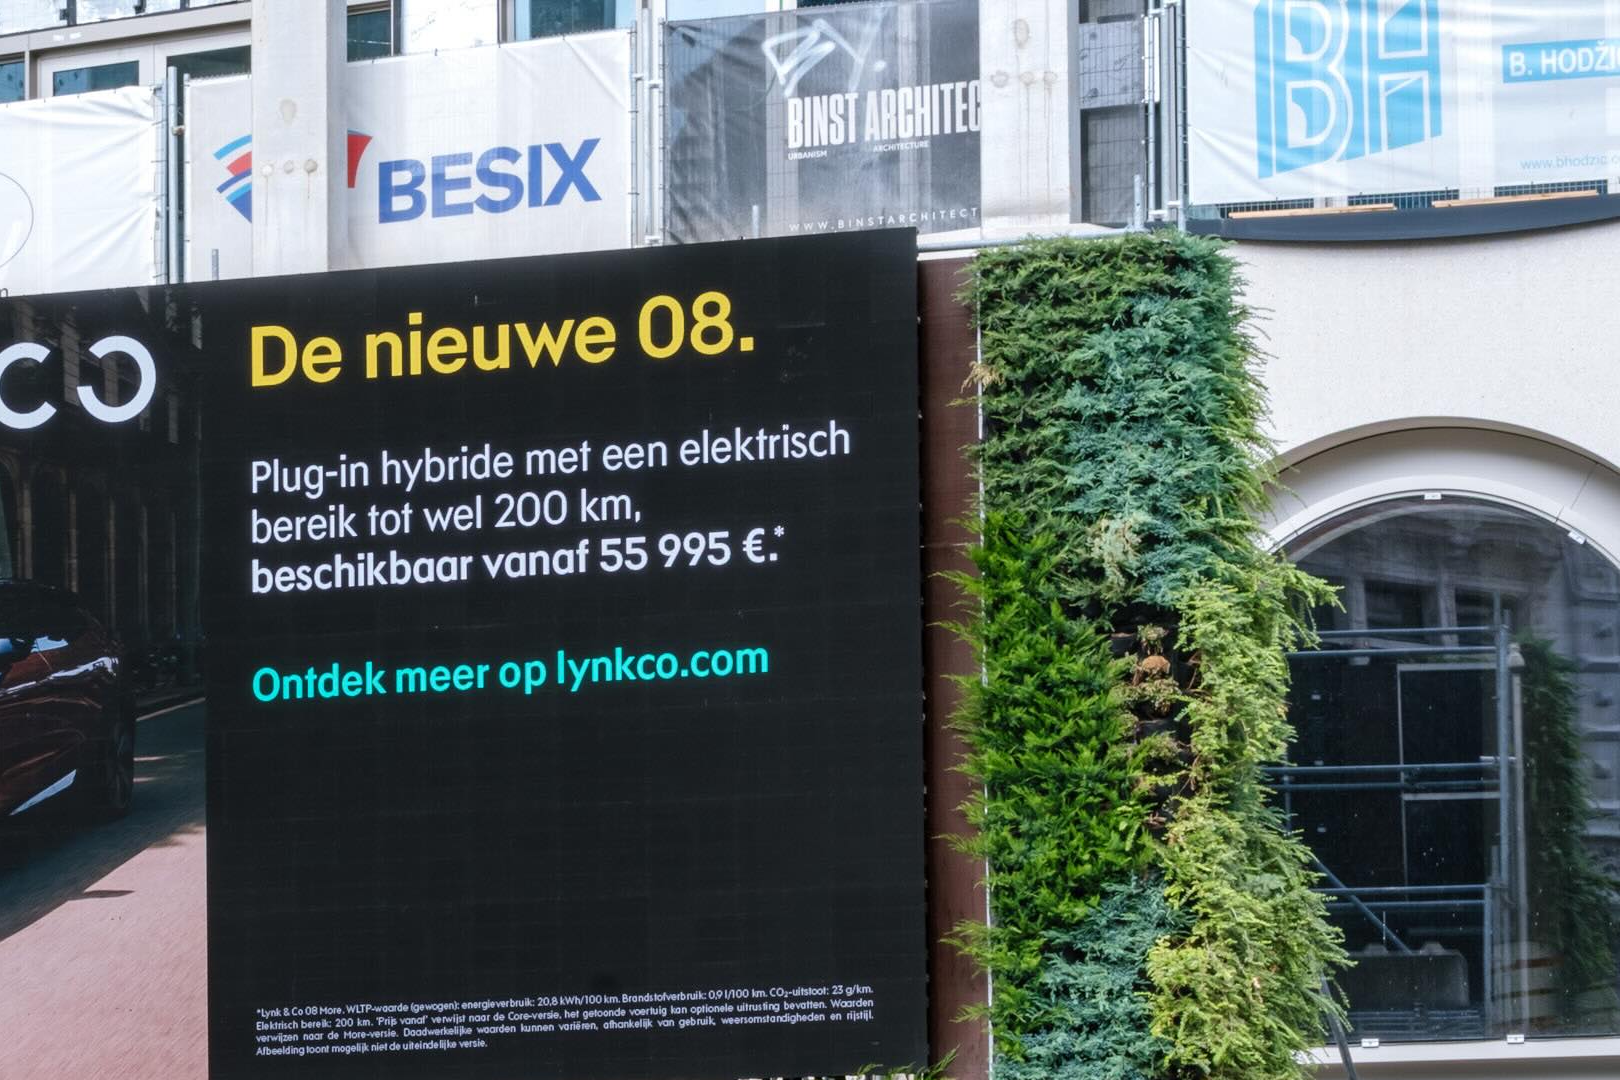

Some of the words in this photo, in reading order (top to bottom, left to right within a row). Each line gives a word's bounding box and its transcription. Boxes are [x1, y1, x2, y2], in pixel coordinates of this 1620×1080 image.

[1509, 52, 1532, 77] B.
[788, 92, 859, 149] BINST
[873, 139, 929, 152] ARCHITECTURE
[379, 138, 601, 224] BESIX
[788, 150, 827, 161] URBANISM
[251, 325, 342, 387] De
[365, 311, 616, 379] nieuwe
[638, 290, 754, 359] 08.
[251, 453, 369, 500] Plug-in
[381, 443, 513, 492] hybride
[525, 440, 591, 476] met
[602, 441, 667, 471] een
[679, 419, 850, 466] elektrisch
[251, 503, 358, 544] bereik
[367, 501, 413, 536] tot
[422, 494, 481, 532] wel
[494, 489, 567, 528] 200
[580, 487, 640, 523] km,
[251, 549, 473, 594] beschikbaar
[481, 538, 589, 579] vanaf
[599, 535, 648, 572] 55
[657, 530, 731, 568] 995
[252, 661, 386, 702] Ontdek
[395, 664, 490, 693] meer
[498, 660, 546, 695] op
[557, 646, 768, 692] lynkco.com
